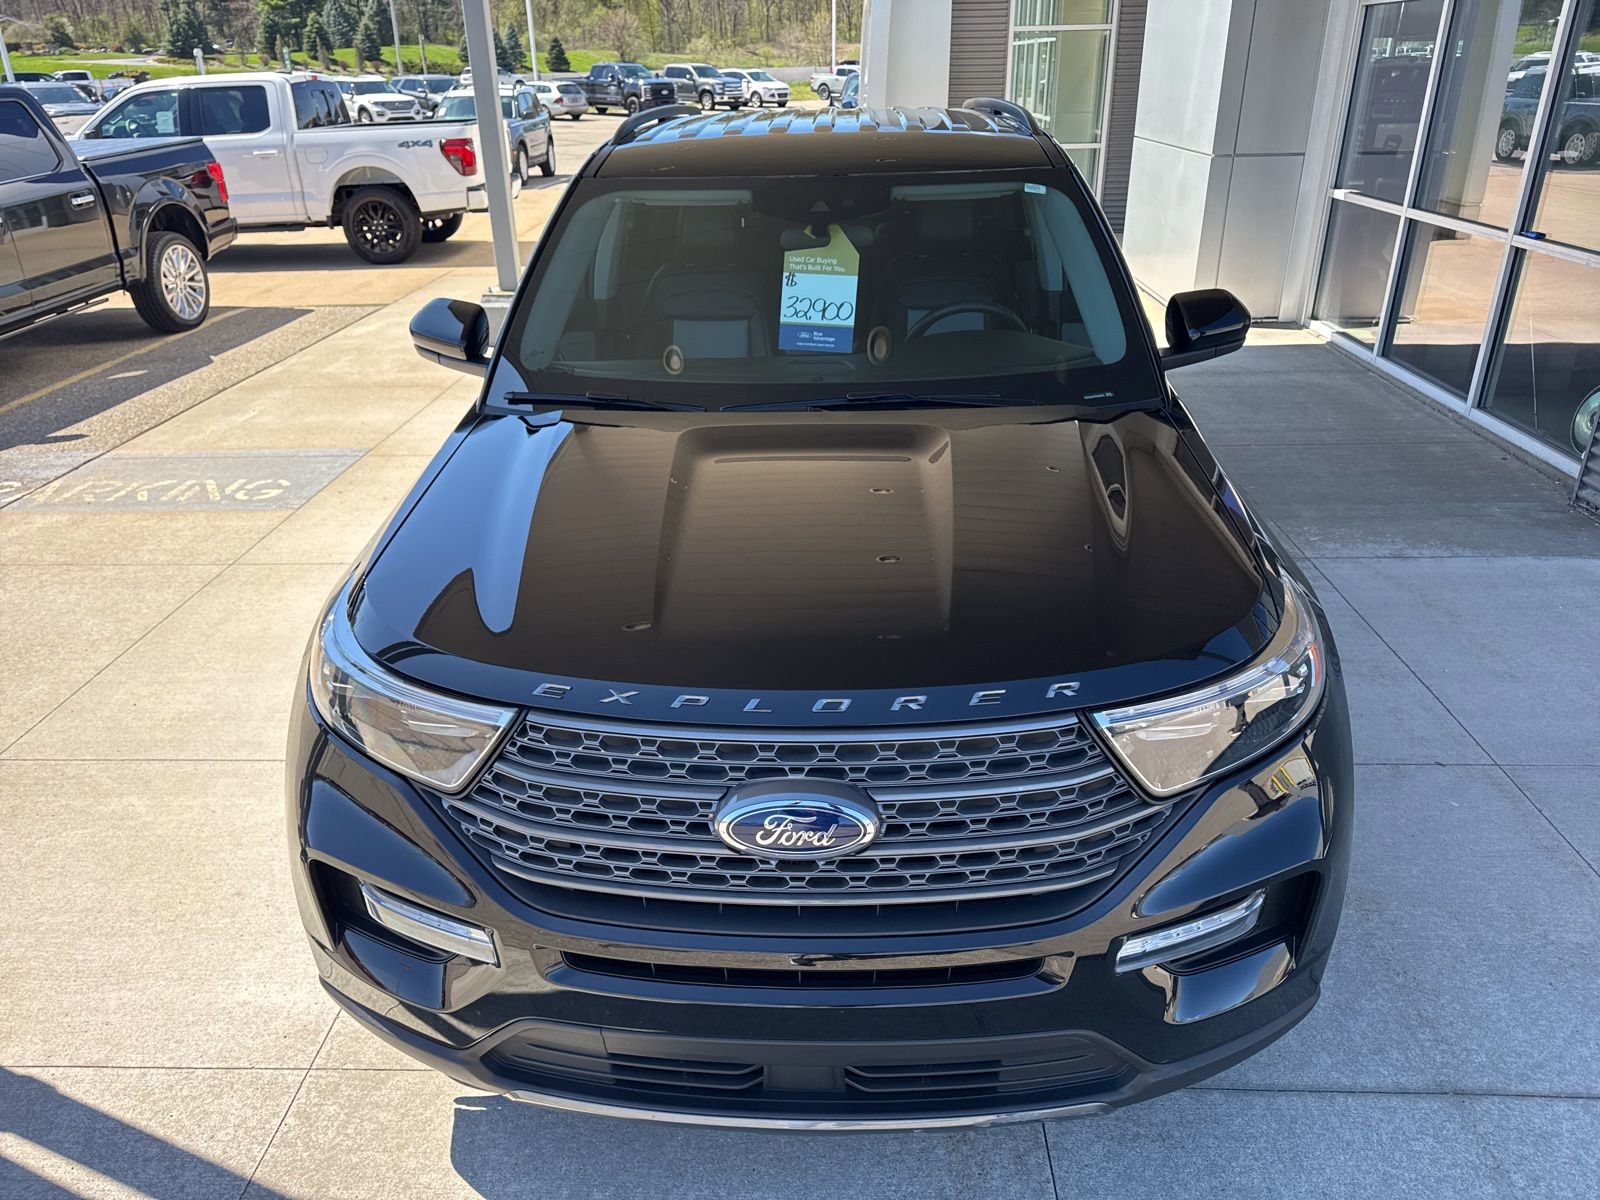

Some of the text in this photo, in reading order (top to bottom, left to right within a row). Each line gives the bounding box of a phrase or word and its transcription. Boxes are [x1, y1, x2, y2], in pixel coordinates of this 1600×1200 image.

[789, 255, 805, 263] Used
[816, 256, 837, 265] Buying
[789, 263, 806, 271] That's
[785, 272, 797, 287] $
[783, 296, 854, 321] 32,900
[532, 681, 1081, 713] EXPLORER
[755, 814, 838, 847] Ford
